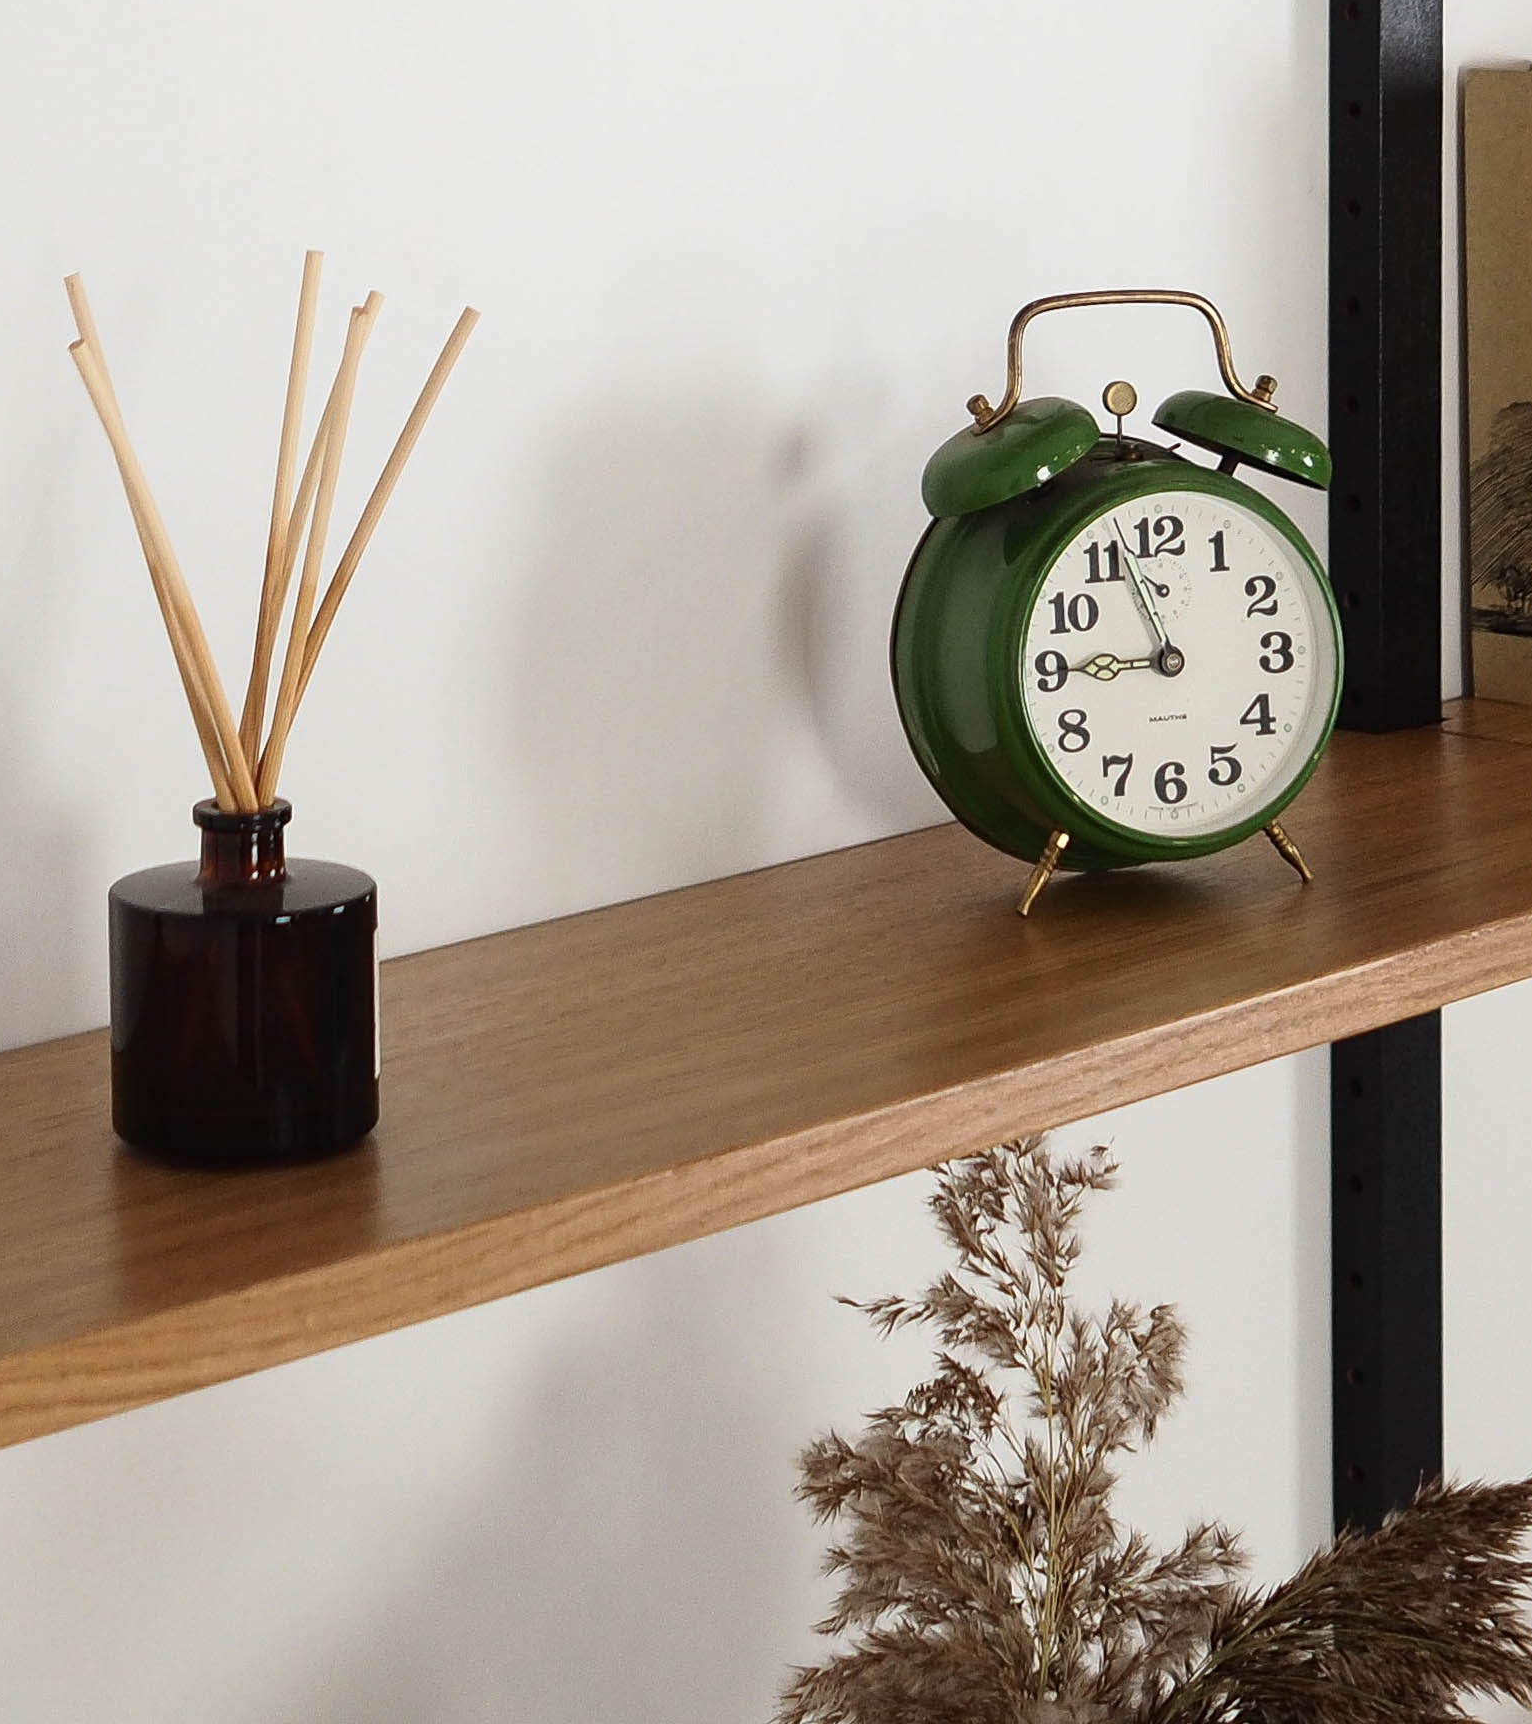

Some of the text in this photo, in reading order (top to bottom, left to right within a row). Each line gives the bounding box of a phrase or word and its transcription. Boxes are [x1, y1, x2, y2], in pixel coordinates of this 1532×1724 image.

[1133, 515, 1185, 559] 12
[1208, 530, 1230, 572] 1
[1083, 540, 1126, 584] 11
[1048, 592, 1099, 635] 10
[1244, 575, 1278, 618] 2
[1034, 650, 1069, 693] 9
[1259, 631, 1294, 674] 3
[1058, 708, 1090, 753] 8
[1148, 713, 1188, 723] MAUTHE
[1239, 693, 1277, 736] 4
[1102, 753, 1133, 797] 7
[1154, 762, 1188, 804] 6
[1208, 743, 1242, 786] 5
